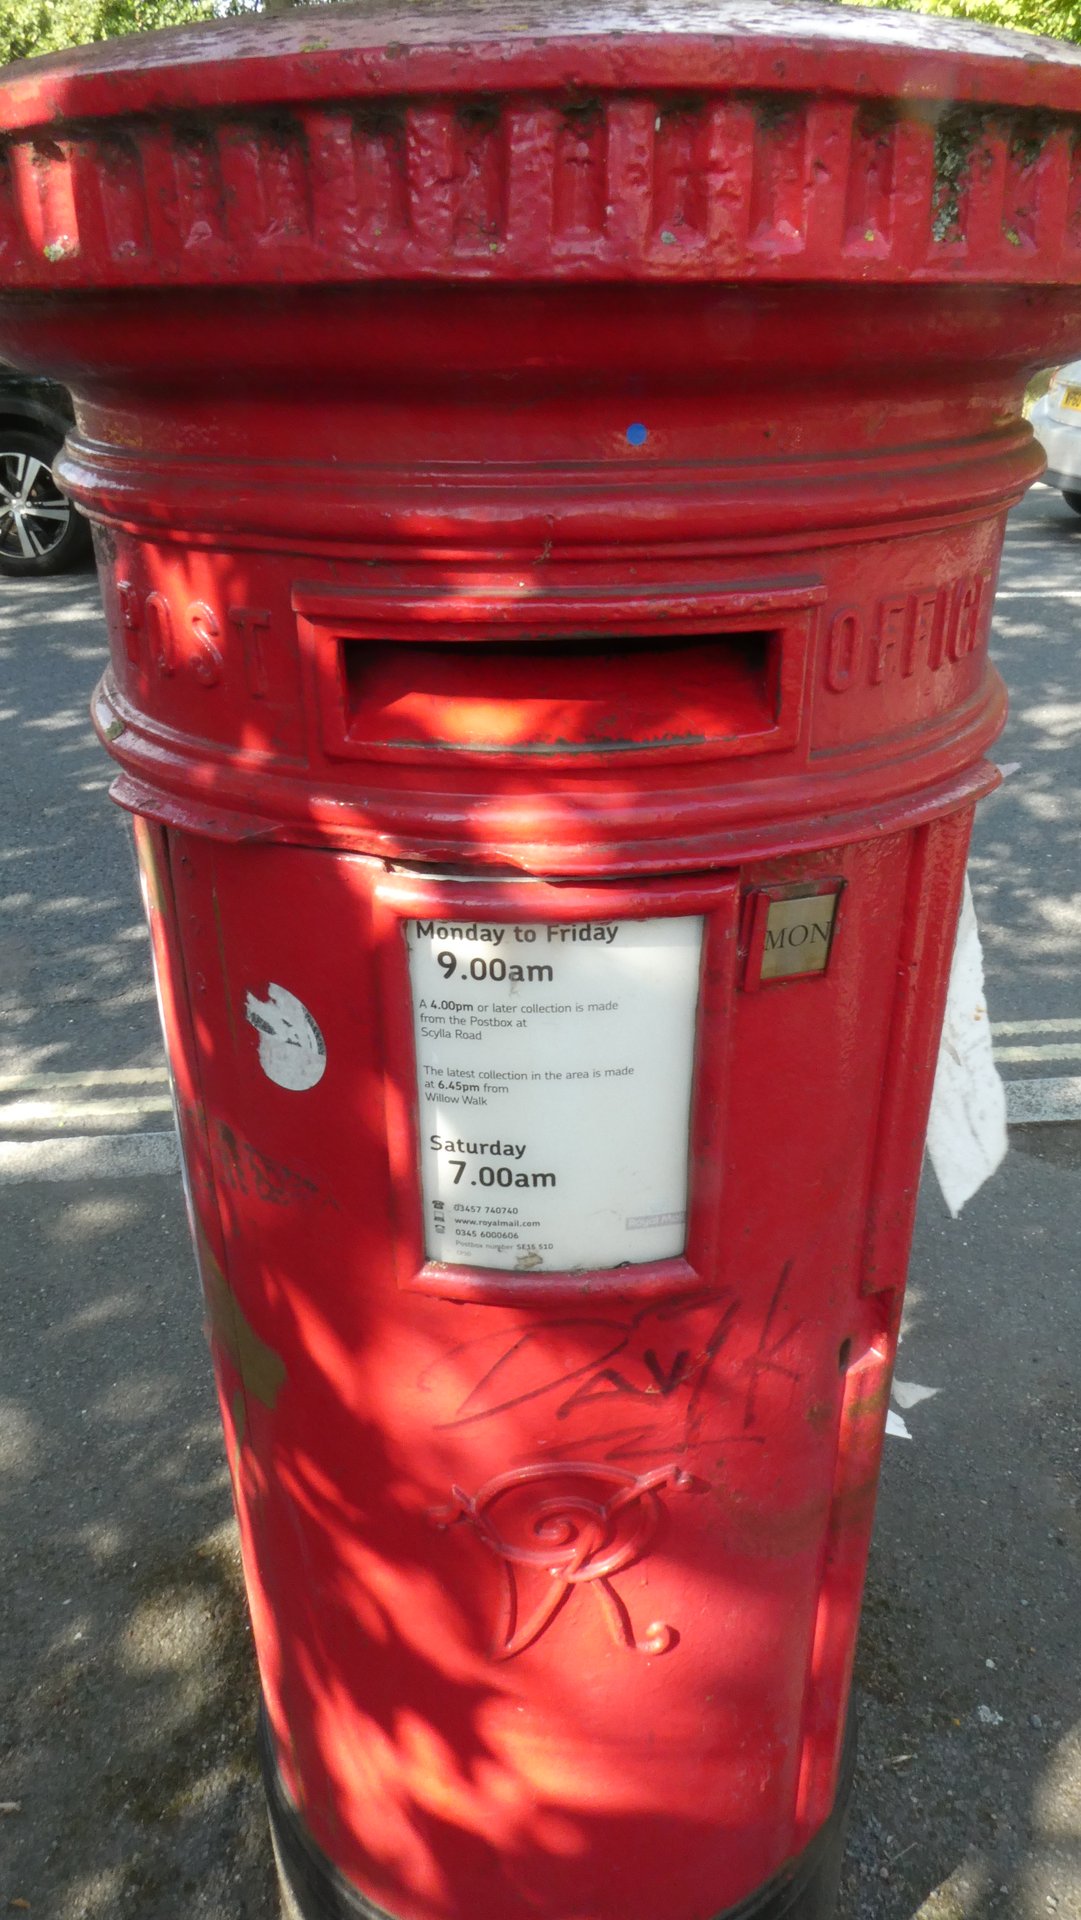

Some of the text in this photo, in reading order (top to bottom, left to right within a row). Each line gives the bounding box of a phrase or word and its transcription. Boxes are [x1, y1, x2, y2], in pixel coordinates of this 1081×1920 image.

[824, 573, 985, 696] OFFIC
[416, 920, 619, 946] Monday to Friday
[764, 921, 832, 951] MON
[436, 951, 554, 983] 9.00am
[419, 999, 619, 1014] A 4.00pm or later collection is made
[420, 1012, 528, 1028] from the Postbox at
[420, 1026, 482, 1041] Scylla Road
[423, 1065, 635, 1081] The latest collection in the area is made
[424, 1080, 509, 1094] at 6.45pm from
[425, 1092, 488, 1106] Willow Walk
[430, 1135, 527, 1160] Saturday
[448, 1160, 557, 1188] 7.00am
[453, 1204, 519, 1215] 03457 740740
[454, 1218, 541, 1228] www.royalmail.com
[455, 1228, 519, 1240] 0345 6000606
[455, 1239, 483, 1249] Postbox
[485, 1243, 514, 1251] number
